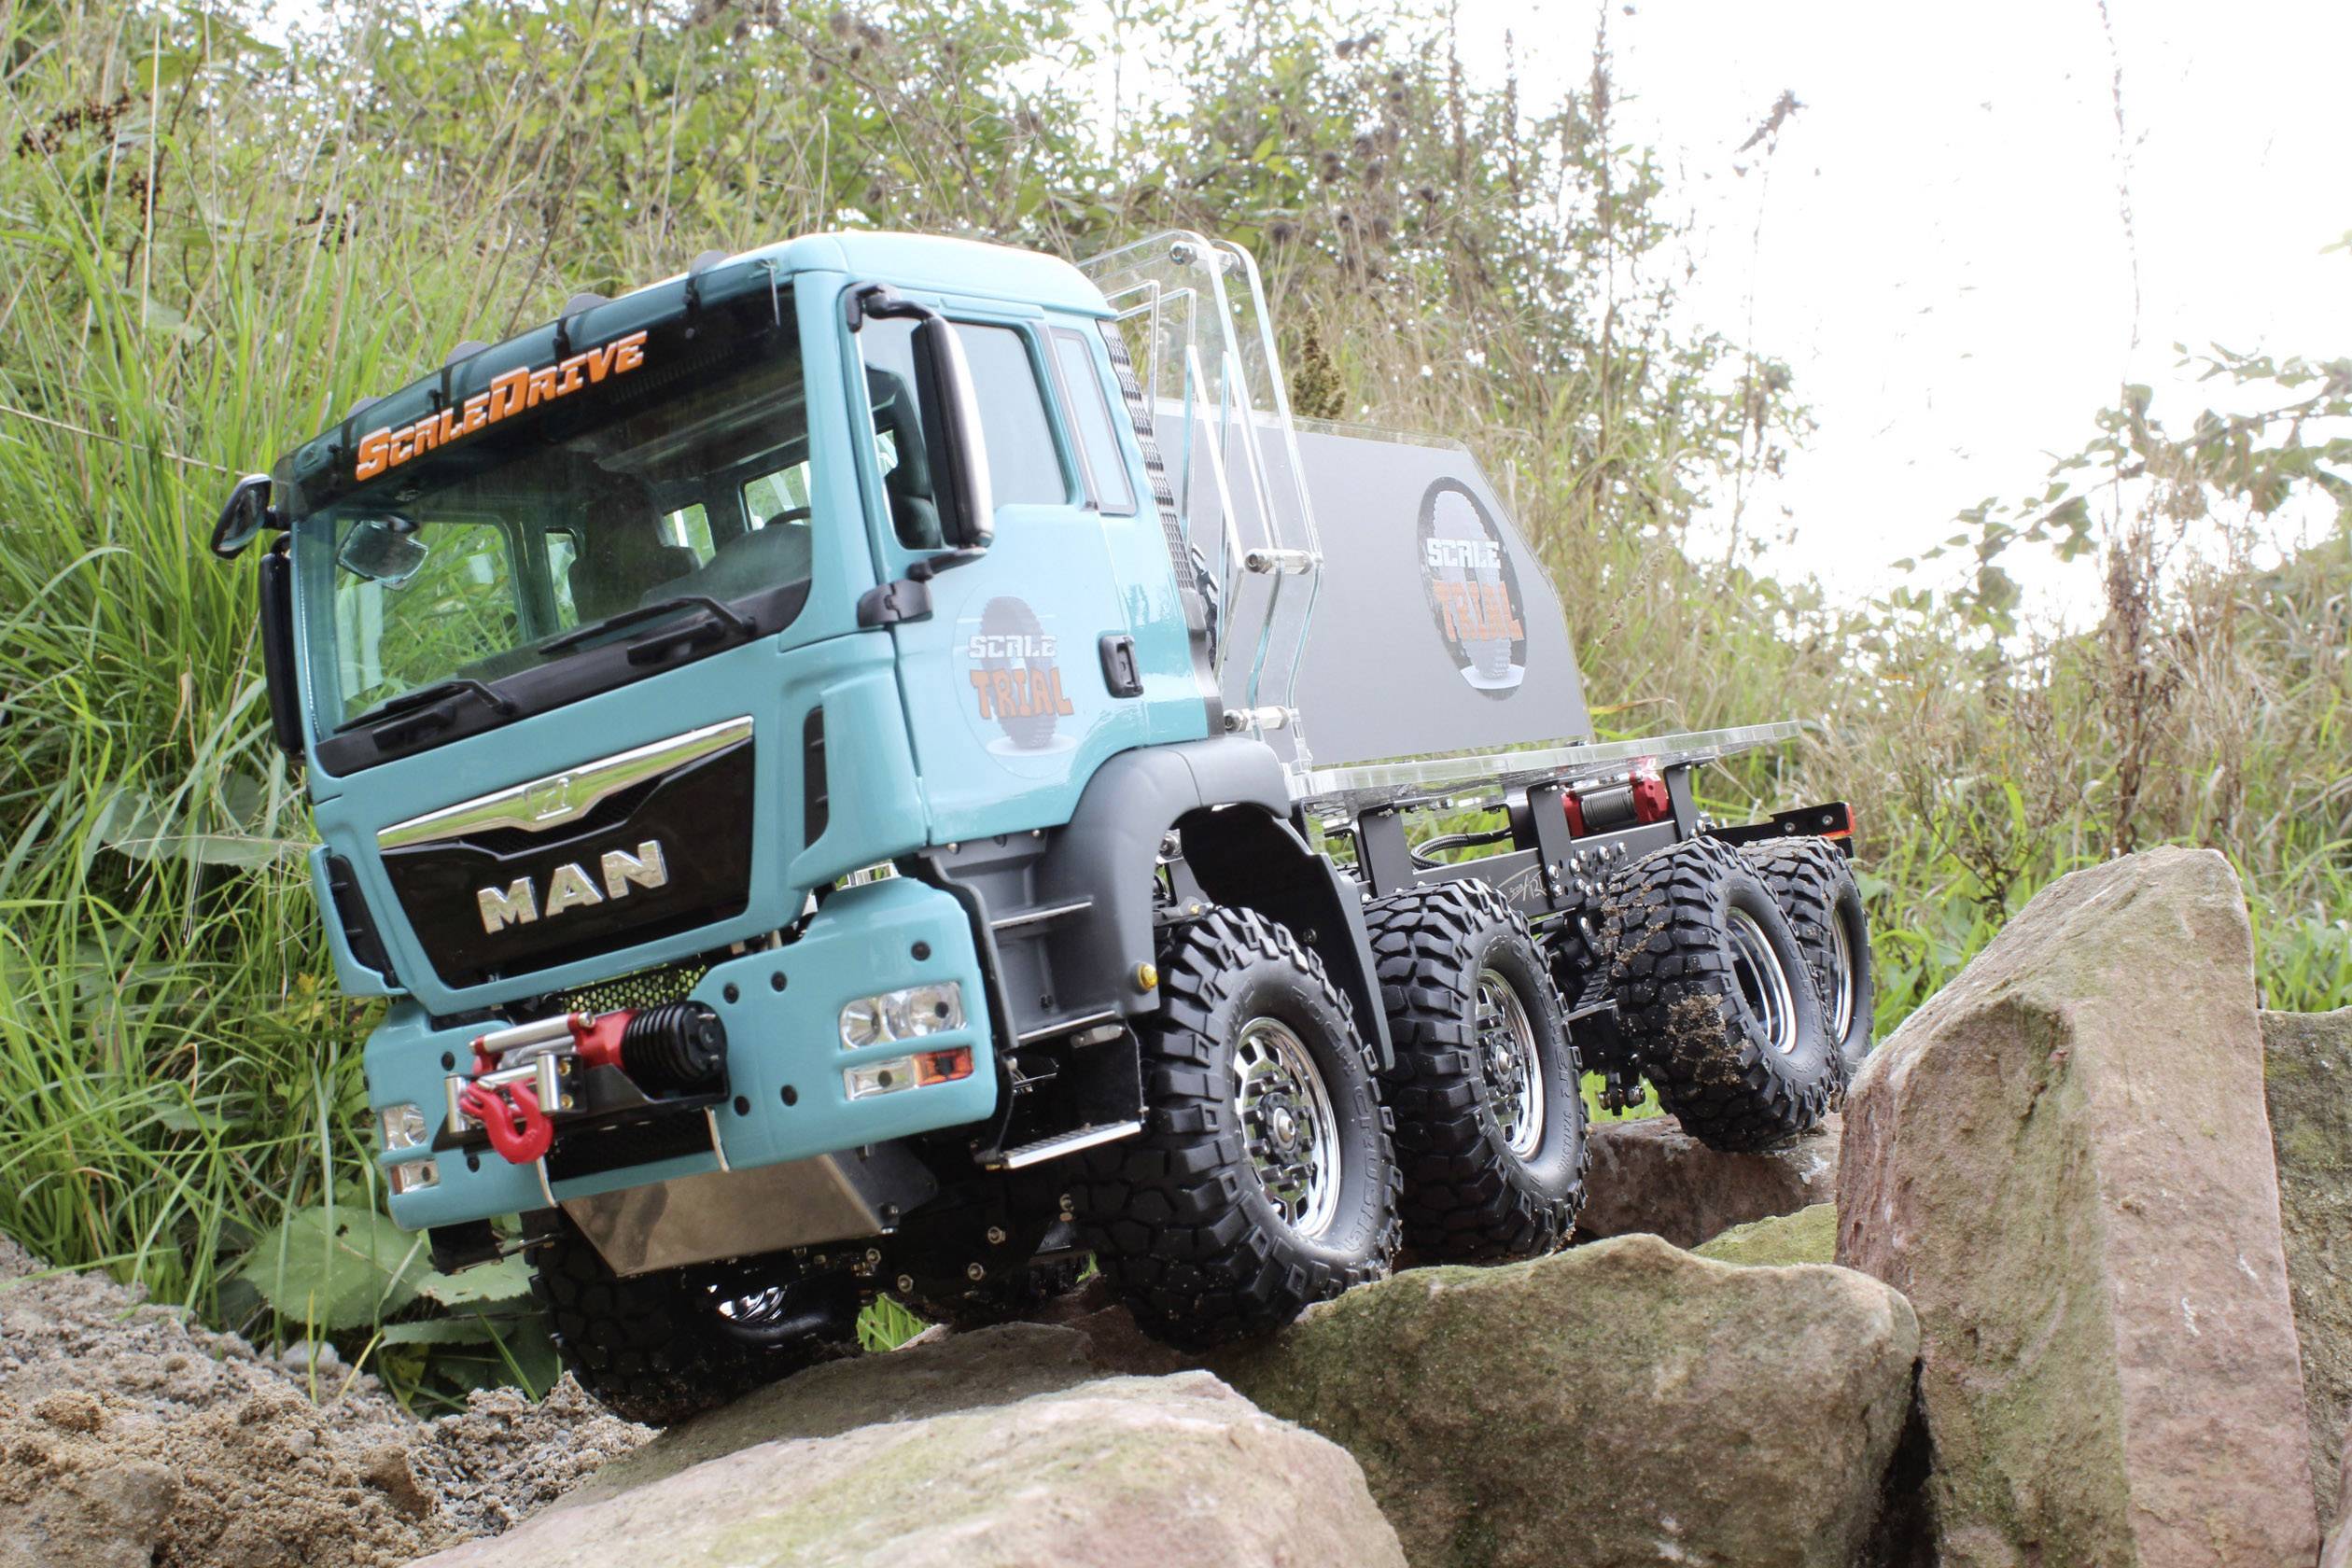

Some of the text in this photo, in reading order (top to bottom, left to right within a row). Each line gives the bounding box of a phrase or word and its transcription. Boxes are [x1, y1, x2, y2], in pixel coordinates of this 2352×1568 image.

[1426, 538, 1502, 569] SCALE
[1433, 580, 1525, 642] TRIAL
[969, 635, 1057, 659] SCALE
[970, 667, 1074, 720] TRIAL
[477, 840, 669, 934] MAN
